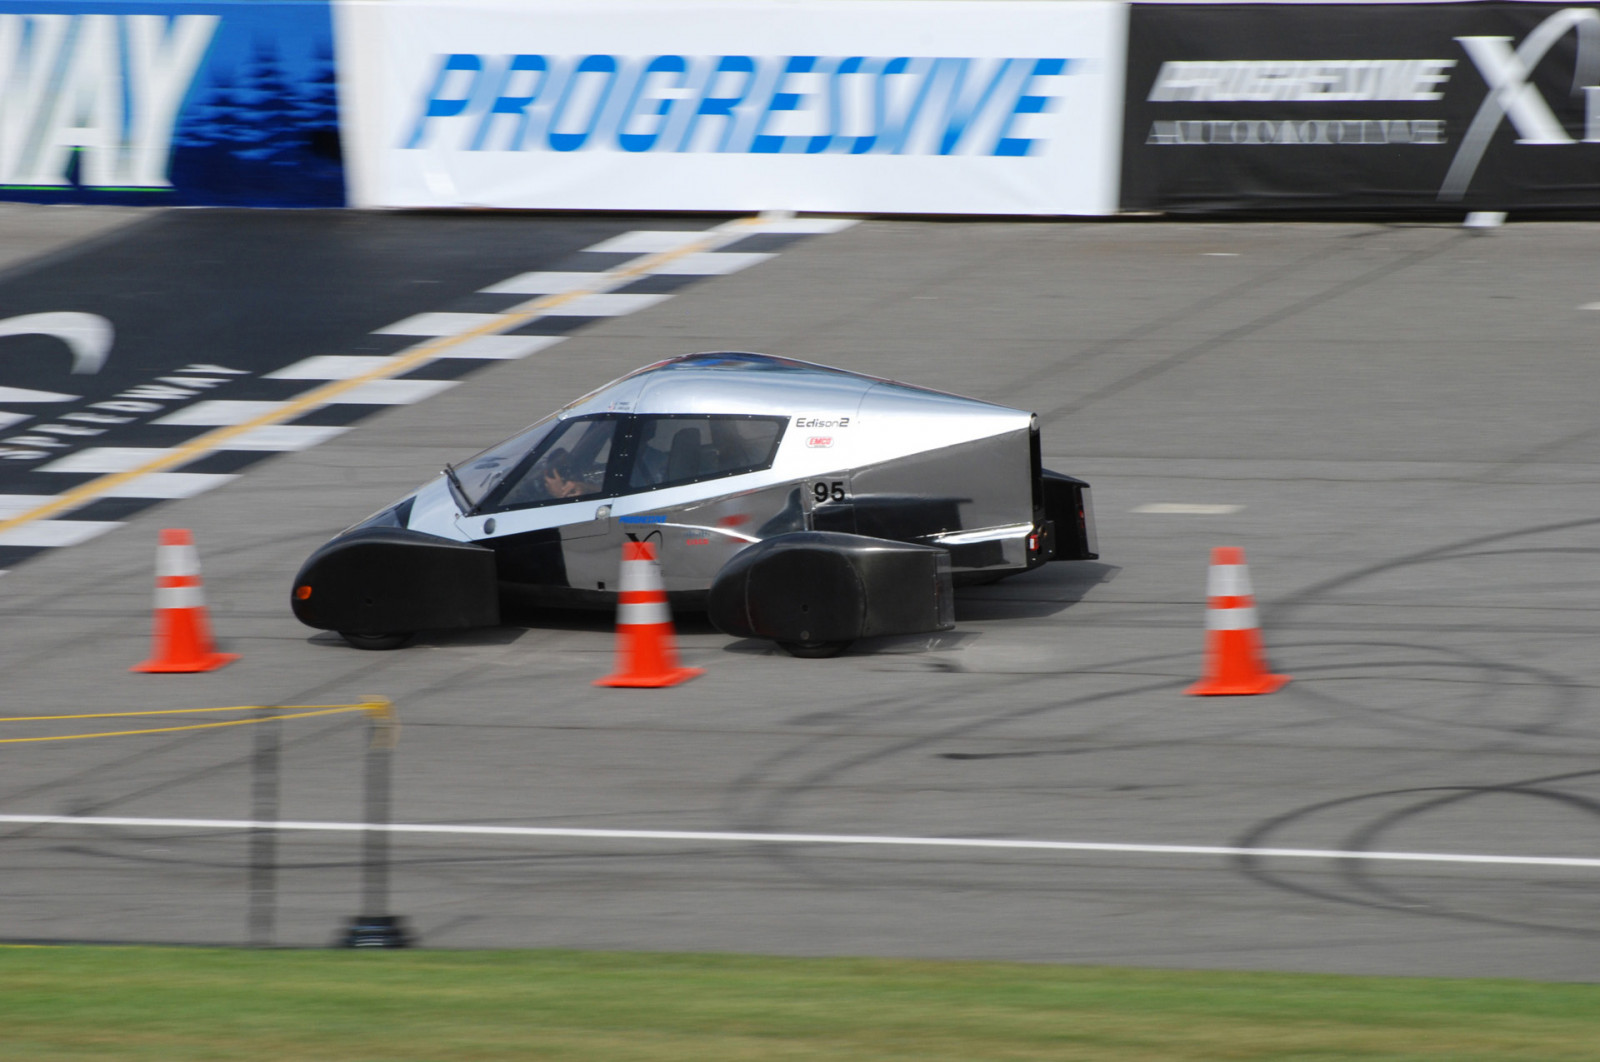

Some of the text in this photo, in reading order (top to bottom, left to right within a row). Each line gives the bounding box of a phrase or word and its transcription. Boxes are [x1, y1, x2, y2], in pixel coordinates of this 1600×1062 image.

[1147, 59, 1458, 102] PROGRESSIVE
[394, 53, 1074, 156] PROGRESSIVE
[1145, 119, 1448, 145] AUTOMOTIVE
[796, 417, 850, 428] Edison2
[813, 481, 846, 503] 95
